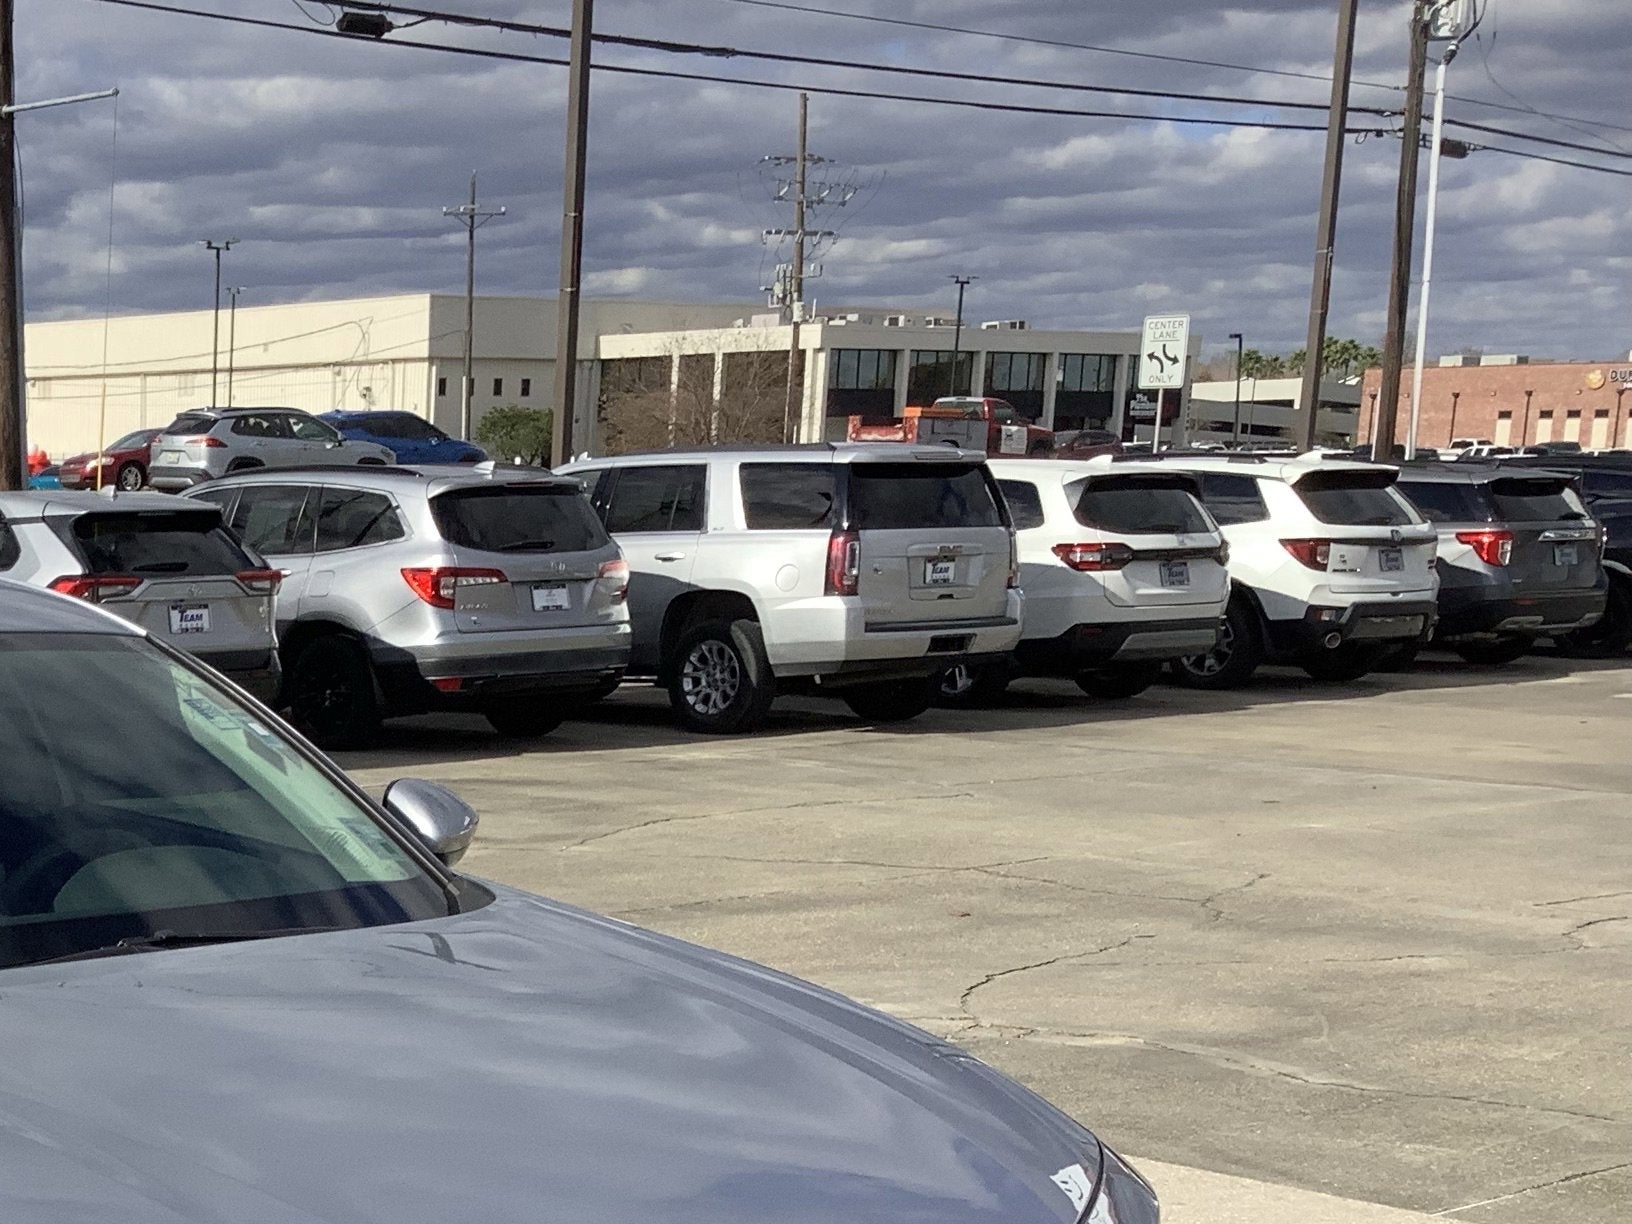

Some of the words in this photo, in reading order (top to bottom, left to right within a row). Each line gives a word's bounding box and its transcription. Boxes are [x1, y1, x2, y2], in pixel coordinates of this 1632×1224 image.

[1148, 320, 1185, 330] CENTER
[1153, 331, 1178, 339] LANE
[1148, 374, 1174, 384] ONLY
